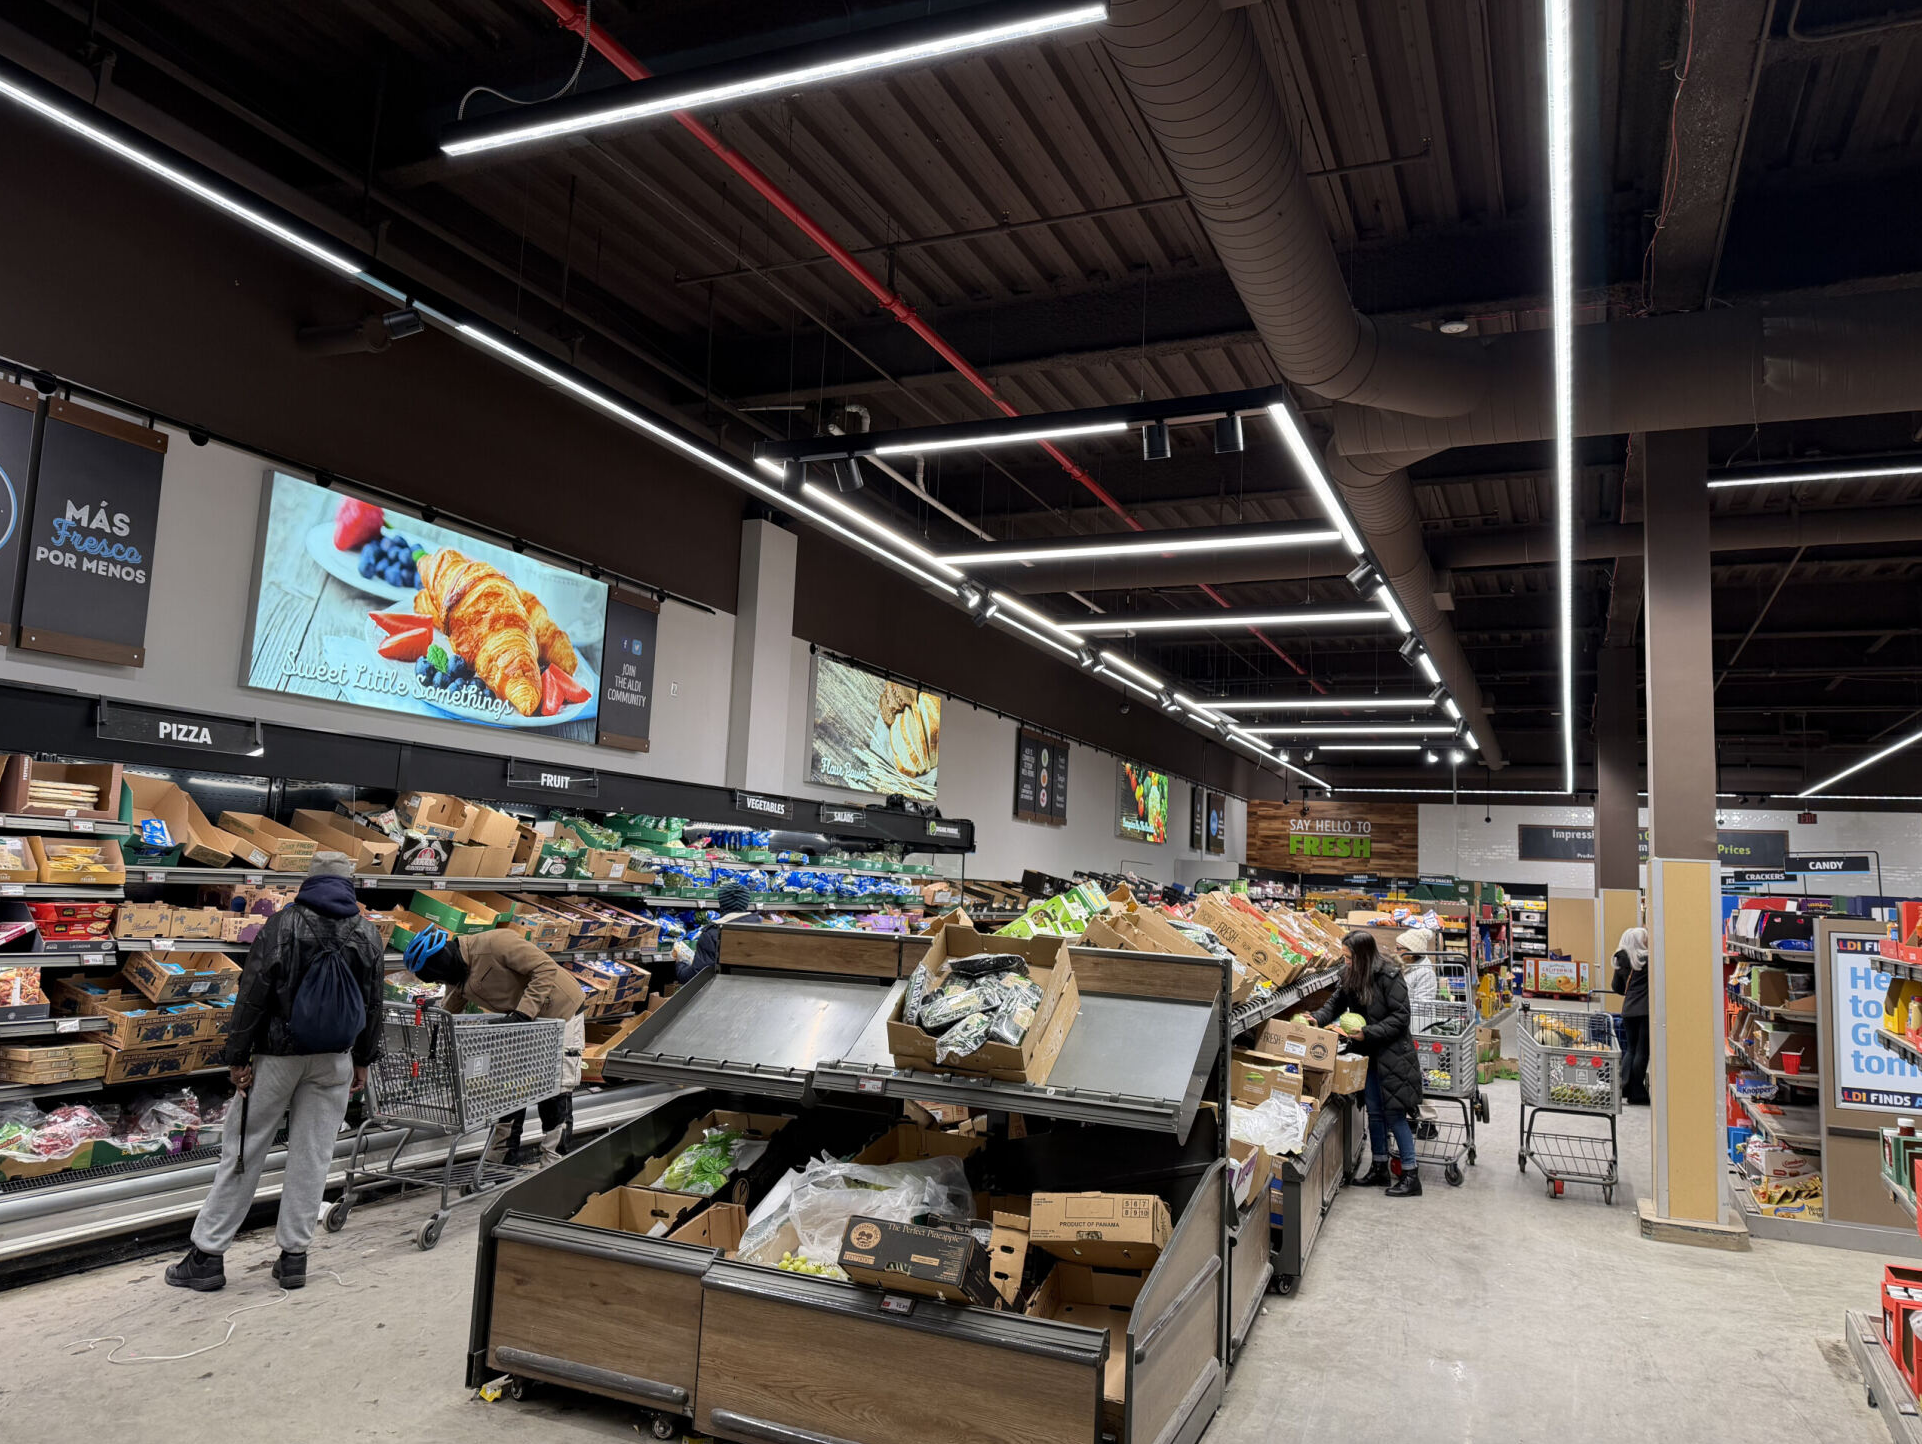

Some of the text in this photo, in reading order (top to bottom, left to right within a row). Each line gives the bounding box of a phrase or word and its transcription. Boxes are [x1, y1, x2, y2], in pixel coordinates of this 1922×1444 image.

[65, 499, 131, 537] MÁS
[51, 517, 142, 564] Fresco
[36, 546, 146, 584] POR MENOS
[622, 663, 637, 677] JOIN
[281, 649, 513, 719] Sweet Little Somethings
[615, 675, 642, 693] THE ALDI
[607, 688, 647, 708] COMMUNITY
[158, 721, 212, 745] PIZZA
[820, 757, 844, 776] Flour
[540, 773, 570, 789] FRUIT
[747, 797, 785, 815] VEGETABLES
[834, 811, 854, 824] SALADS
[1289, 819, 1372, 834] SAY HELLO TO
[1289, 834, 1371, 858] FRESH
[1718, 844, 1751, 855] Prices
[1808, 861, 1844, 870] CANDY
[1745, 873, 1785, 881] CRACKERS
[1216, 920, 1240, 944] FRESH
[1838, 939, 1862, 951] LDI
[1843, 1091, 1867, 1103] LDI
[1870, 1093, 1911, 1107] FINDS
[888, 1223, 900, 1233] The
[902, 1225, 926, 1237] Perfect
[926, 1229, 960, 1243] Pineapple
